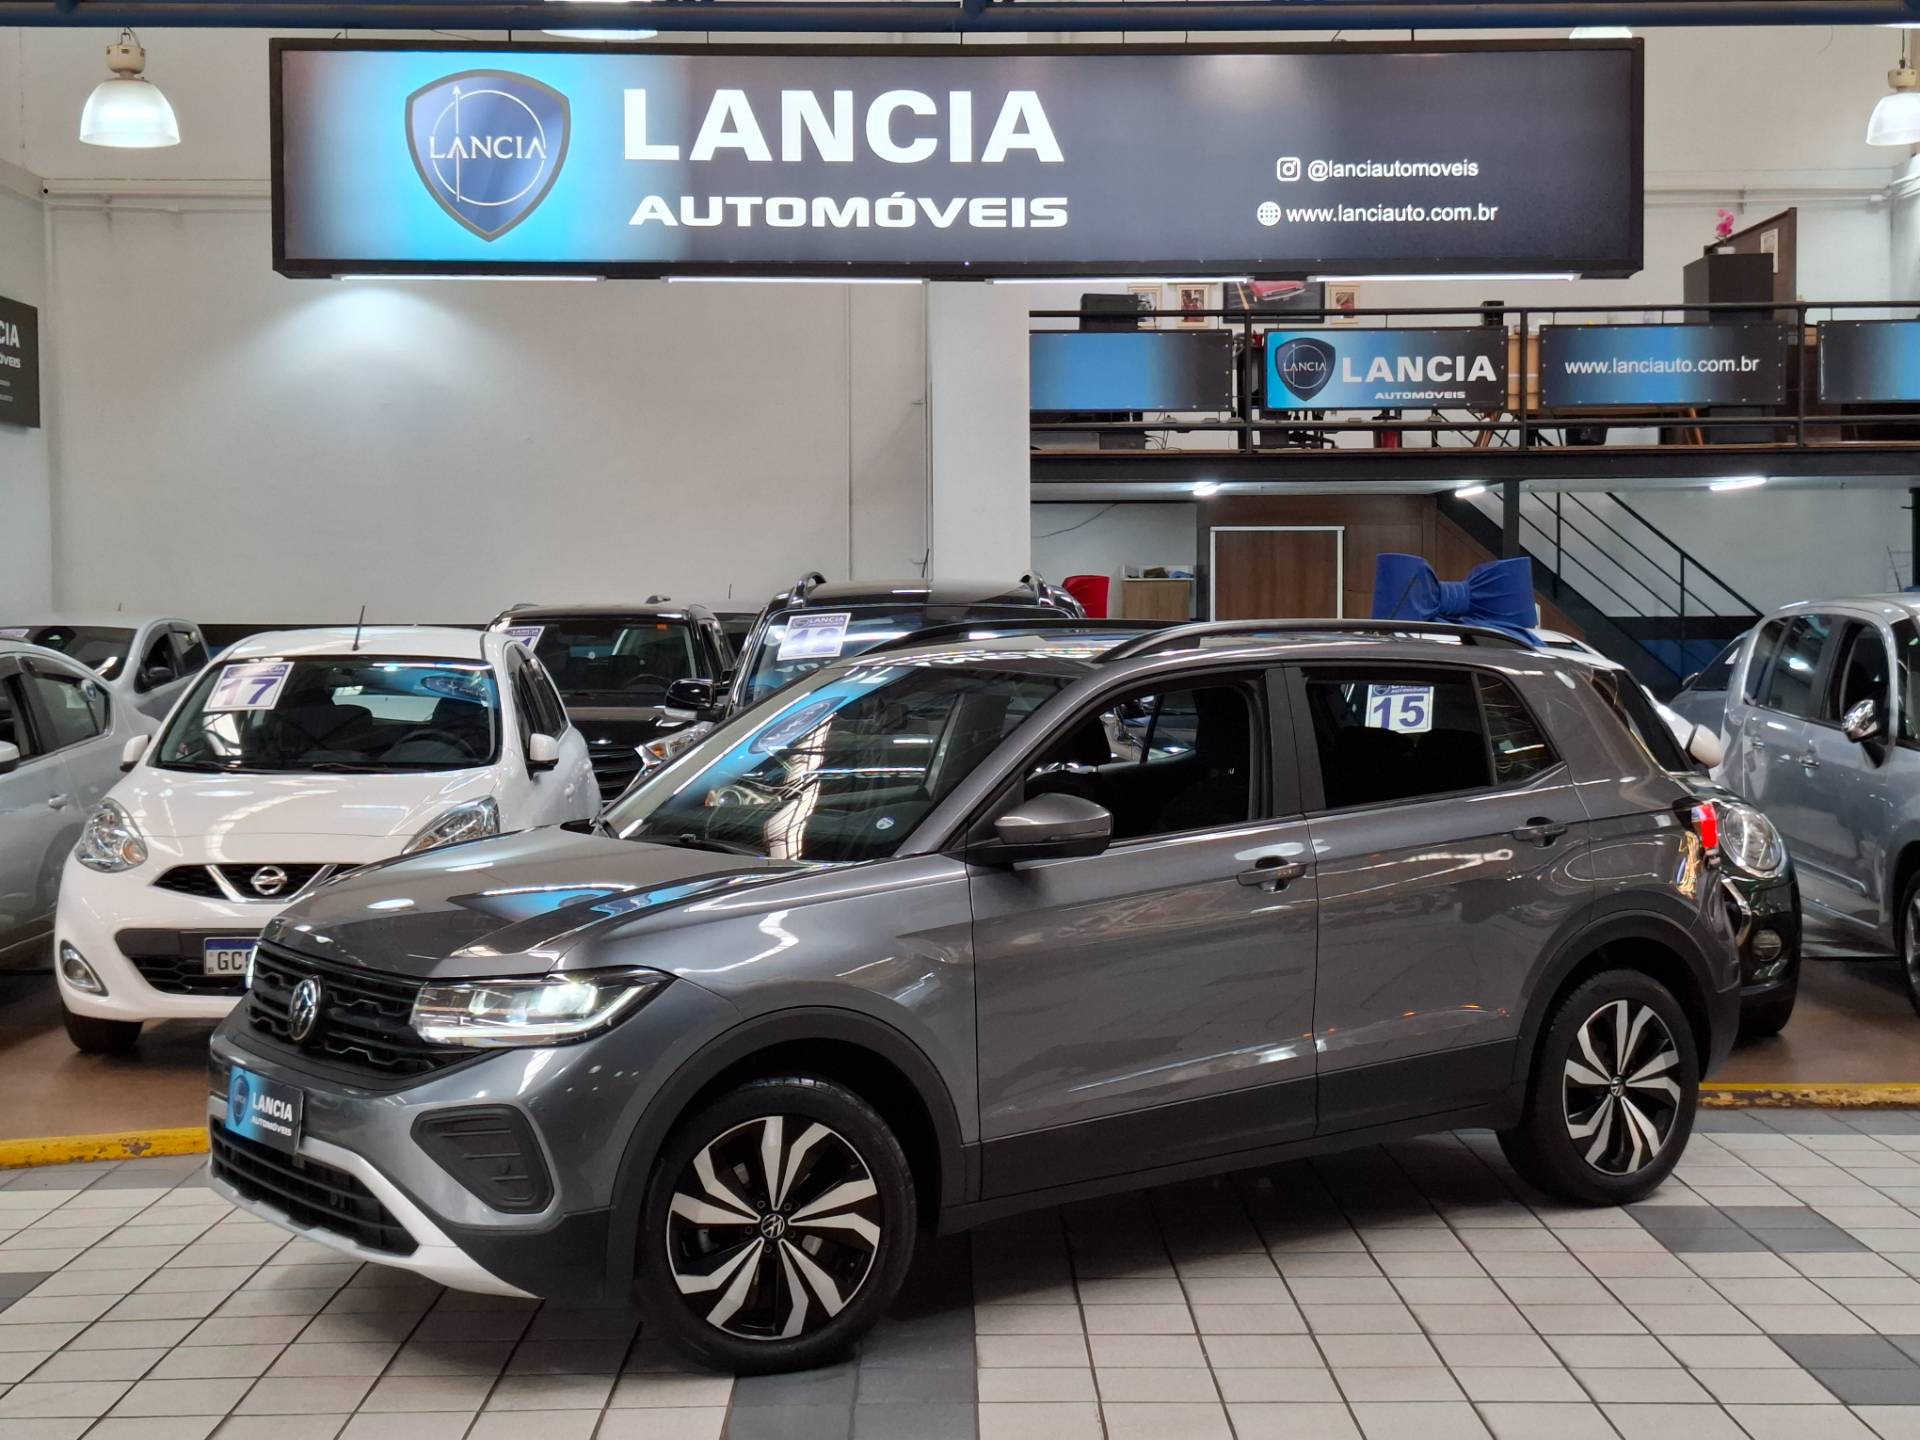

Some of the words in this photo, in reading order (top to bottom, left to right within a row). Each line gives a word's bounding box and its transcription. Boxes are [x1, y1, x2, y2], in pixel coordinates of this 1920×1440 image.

[623, 88, 1065, 163] LANCIA
[429, 135, 547, 159] LANCIA
[1307, 159, 1479, 182] @lanciautomoveis
[628, 191, 1068, 228] AUTOMÓVEIS
[1286, 203, 1499, 222] www.lanciauto.com.br
[1283, 362, 1327, 372] LANCIA
[1342, 355, 1497, 382] LANCIA
[1564, 356, 1760, 374] www.lanciauto.com.br
[1374, 391, 1466, 399] AUTOMÓVEIS
[220, 678, 279, 705] 17
[1373, 695, 1425, 729] 15
[252, 1091, 293, 1122] LANCIA
